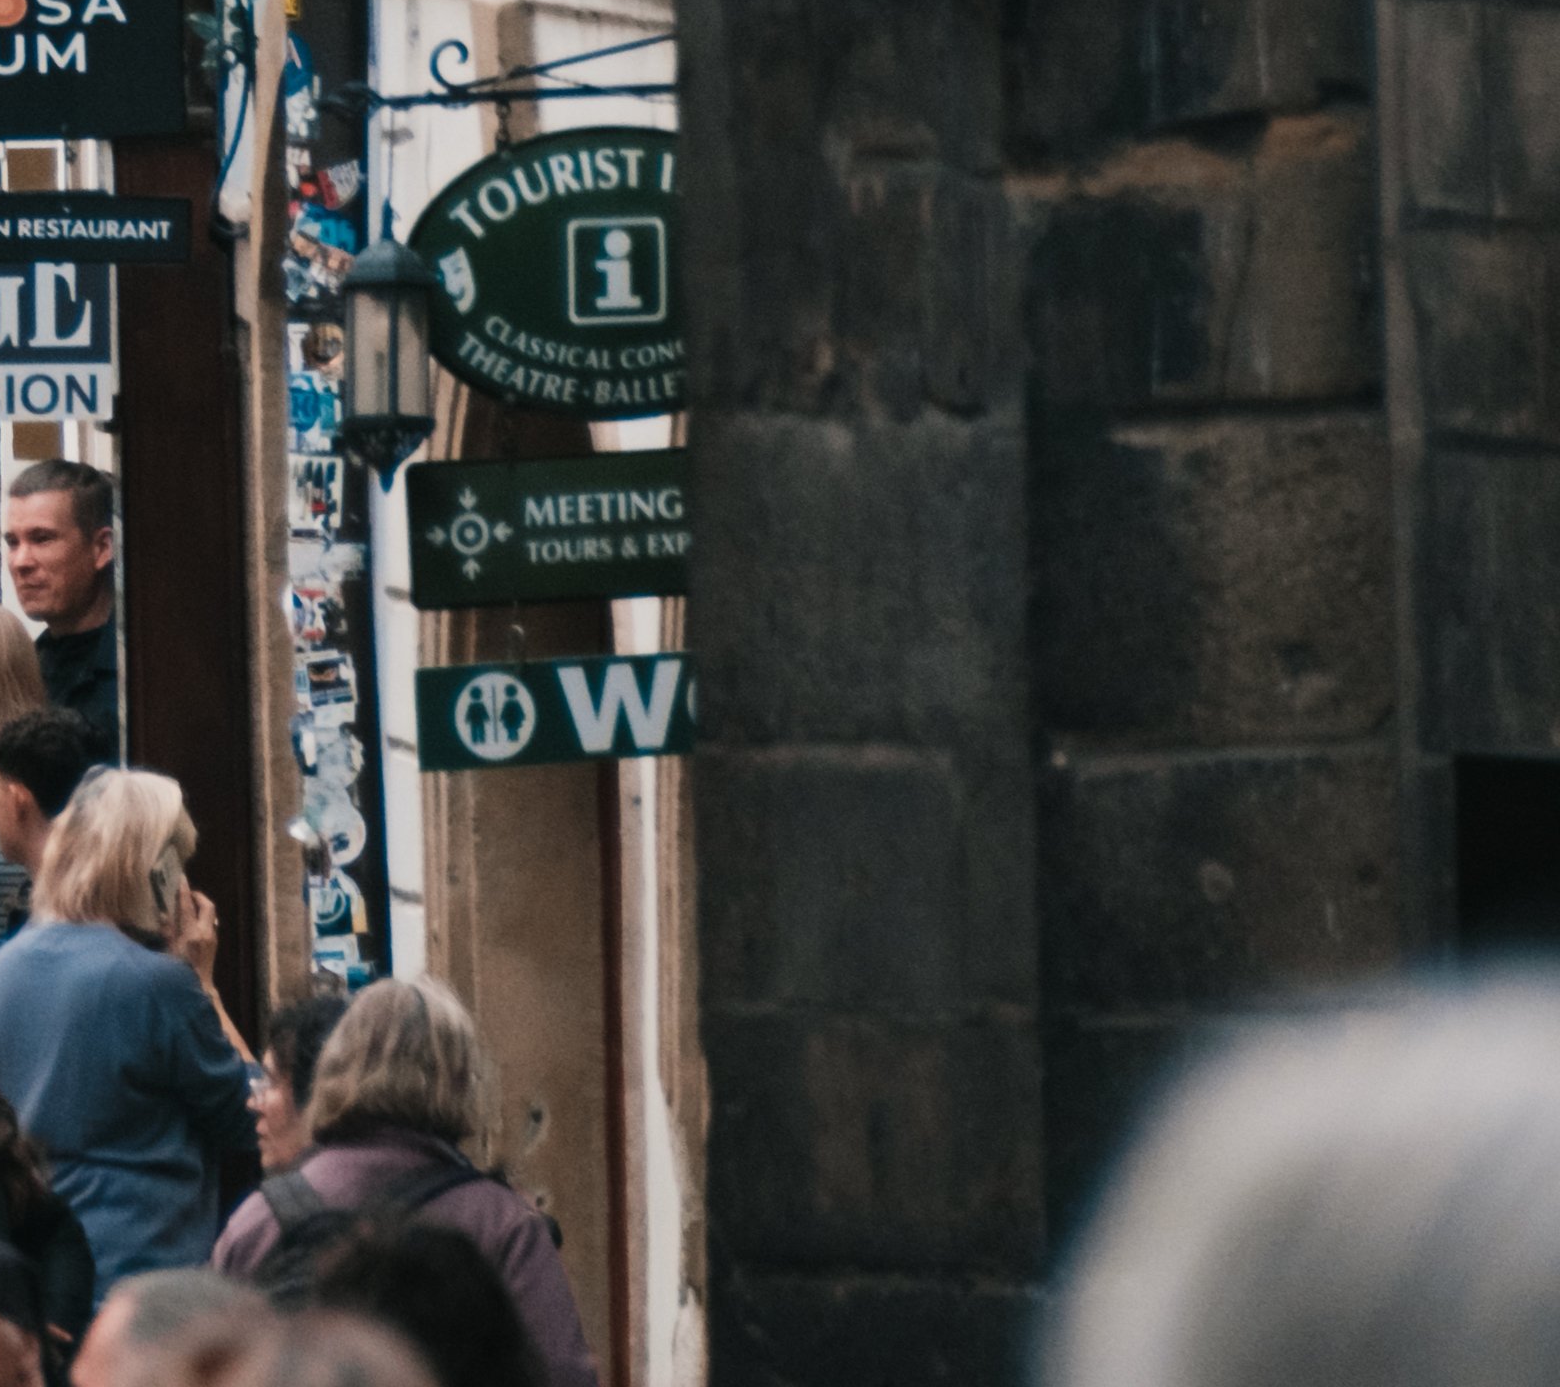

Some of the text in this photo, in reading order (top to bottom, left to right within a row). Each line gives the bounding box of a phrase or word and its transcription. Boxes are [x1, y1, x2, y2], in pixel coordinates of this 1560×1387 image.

[448, 147, 645, 240] TOURIST
[17, 217, 172, 241] RESTAURANT
[457, 331, 580, 405] THEATRE
[484, 315, 612, 371] CLASSICAL
[523, 487, 685, 528] MEETING
[526, 535, 613, 565] TOURS
[620, 535, 639, 560] &
[556, 658, 697, 754] W
